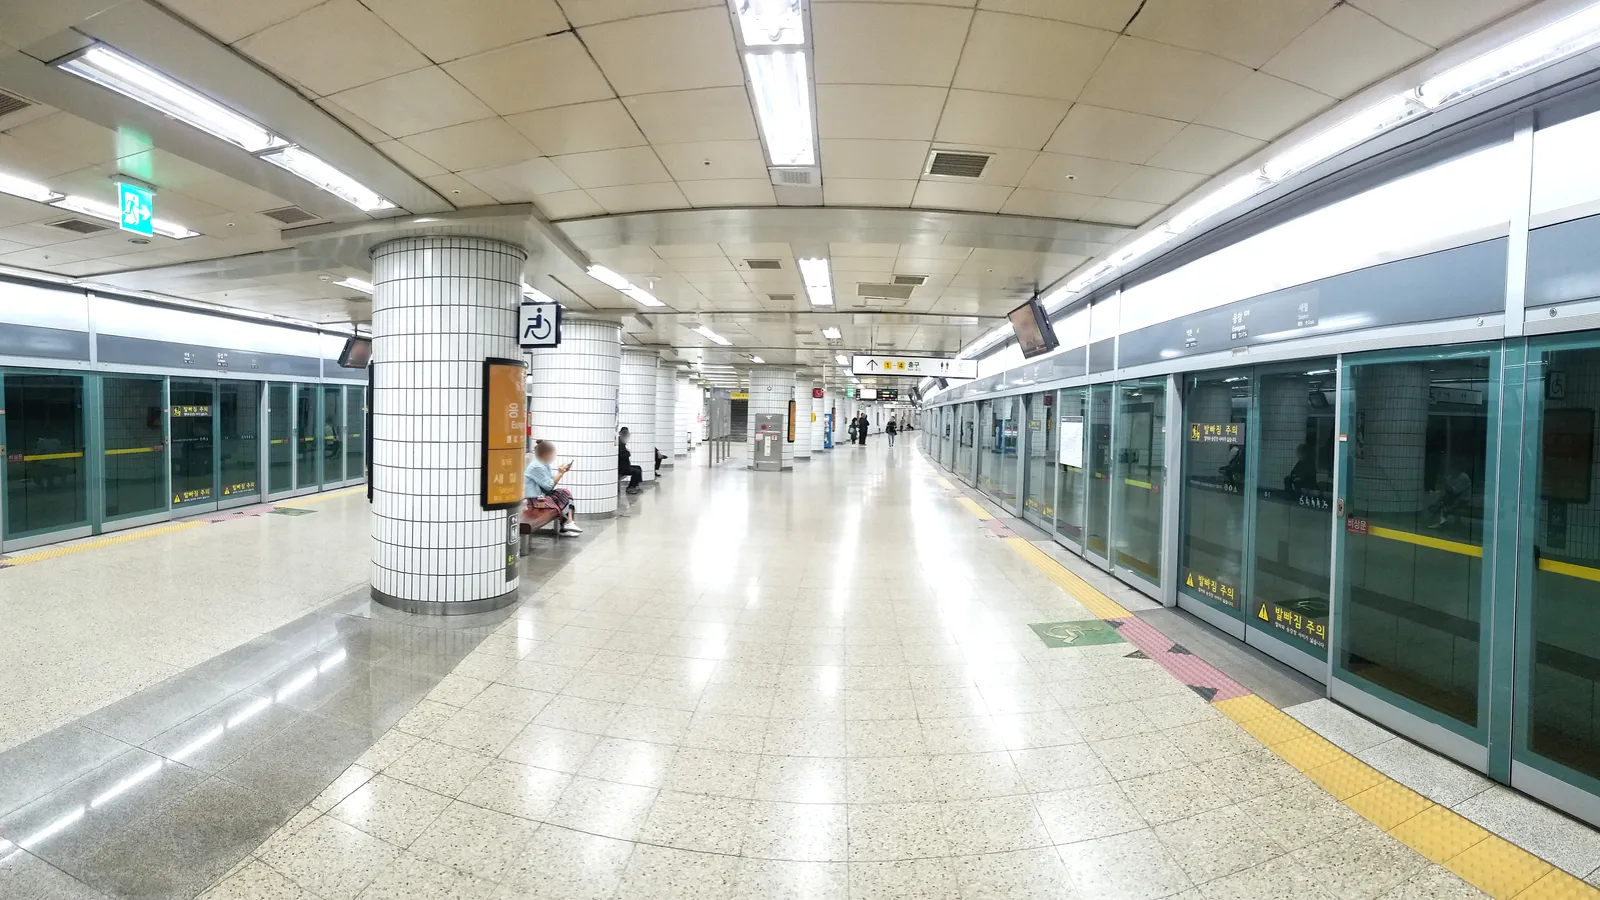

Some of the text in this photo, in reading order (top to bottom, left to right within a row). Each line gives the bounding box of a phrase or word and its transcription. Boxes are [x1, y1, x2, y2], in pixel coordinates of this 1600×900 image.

[1203, 424, 1238, 435] 발빠짐 주의
[183, 489, 199, 499] 발빠짐
[200, 487, 210, 495] 주의
[1347, 518, 1366, 531] 비상문
[1198, 575, 1217, 593] 발빠짐
[1220, 584, 1234, 600] 주의
[1275, 606, 1325, 640] 발빠짐 주의
